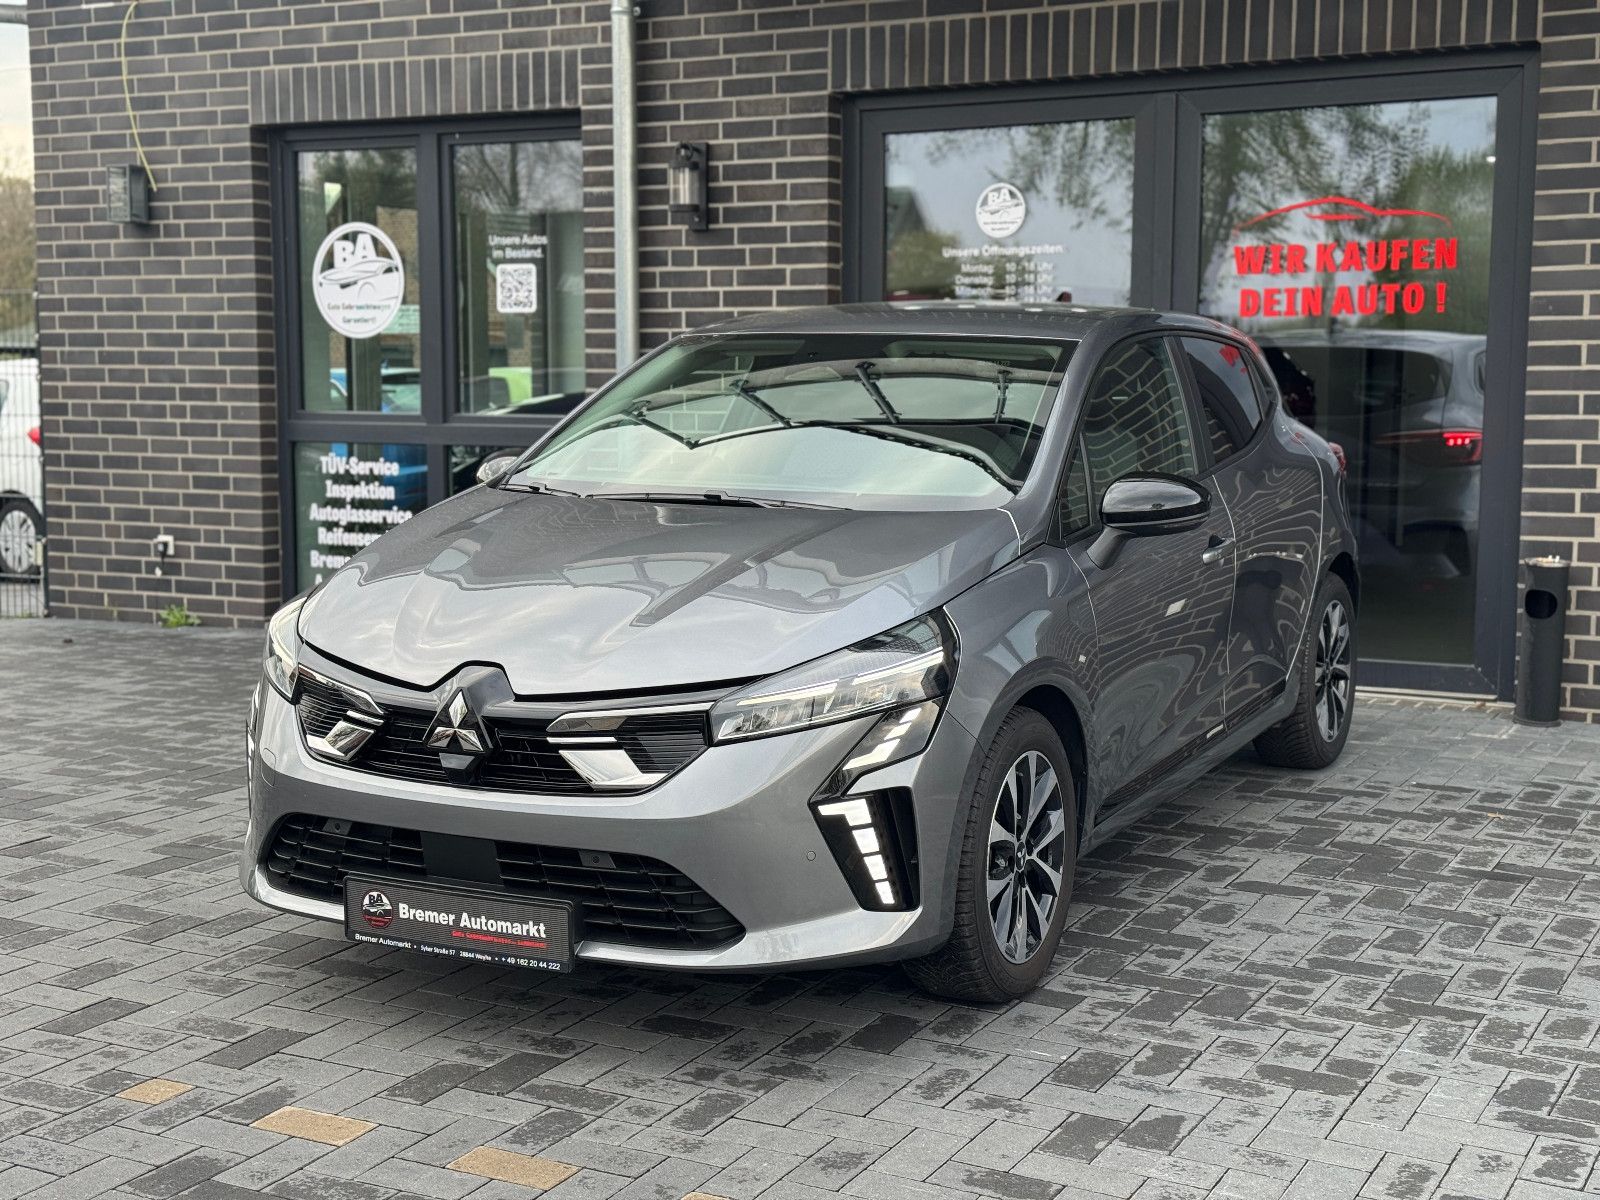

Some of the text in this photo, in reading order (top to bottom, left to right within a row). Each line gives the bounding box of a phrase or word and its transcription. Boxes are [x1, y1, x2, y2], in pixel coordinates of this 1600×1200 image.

[986, 188, 1011, 206] BA
[333, 232, 377, 268] BA
[488, 233, 548, 246] Unsere Autos
[942, 246, 979, 258] Unsere
[1234, 238, 1457, 275] WIR KAUFEN
[1239, 281, 1447, 318] DEIN AUTO !
[320, 452, 400, 477] TÜV-Service
[325, 479, 396, 502] Inspektion
[309, 502, 413, 526] Autoglasservice
[368, 893, 384, 906] BA
[398, 902, 456, 926] Bremer
[460, 911, 547, 938] Automarkt
[355, 933, 378, 943] Bremer
[379, 937, 412, 949] Automarkt
[517, 958, 529, 967] 162
[529, 959, 538, 967] 20
[548, 962, 561, 971] 222
